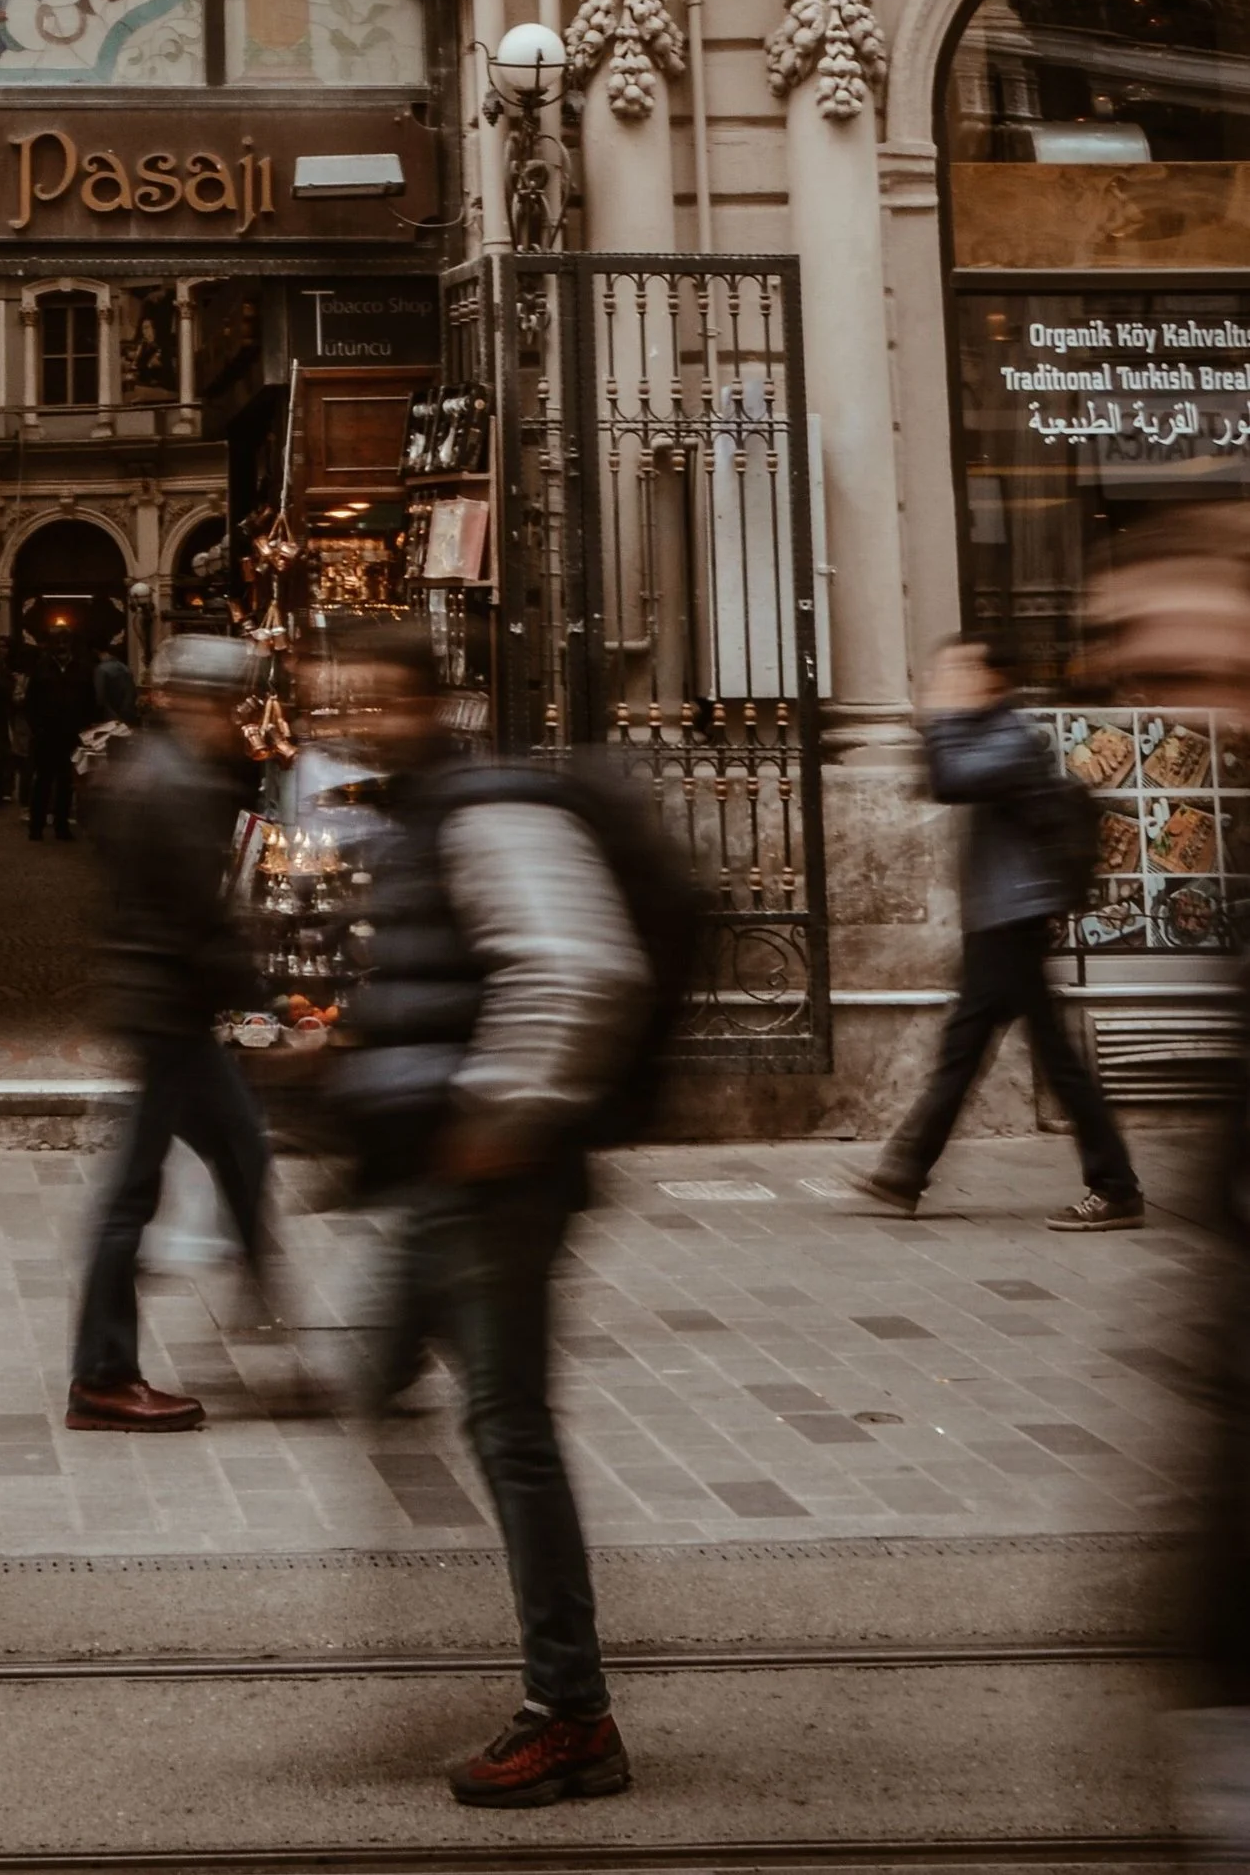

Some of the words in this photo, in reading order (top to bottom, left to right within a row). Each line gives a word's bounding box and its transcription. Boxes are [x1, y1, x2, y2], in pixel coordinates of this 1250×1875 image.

[7, 128, 276, 233] Pasajı
[388, 297, 433, 317] Shop
[1029, 319, 1113, 354] Organik
[1115, 322, 1158, 354] Köy
[1000, 362, 1113, 390] Traditional
[1116, 362, 1196, 390] Turkish
[1028, 400, 1123, 445] الطبيعية
[1133, 400, 1199, 445] القرية
